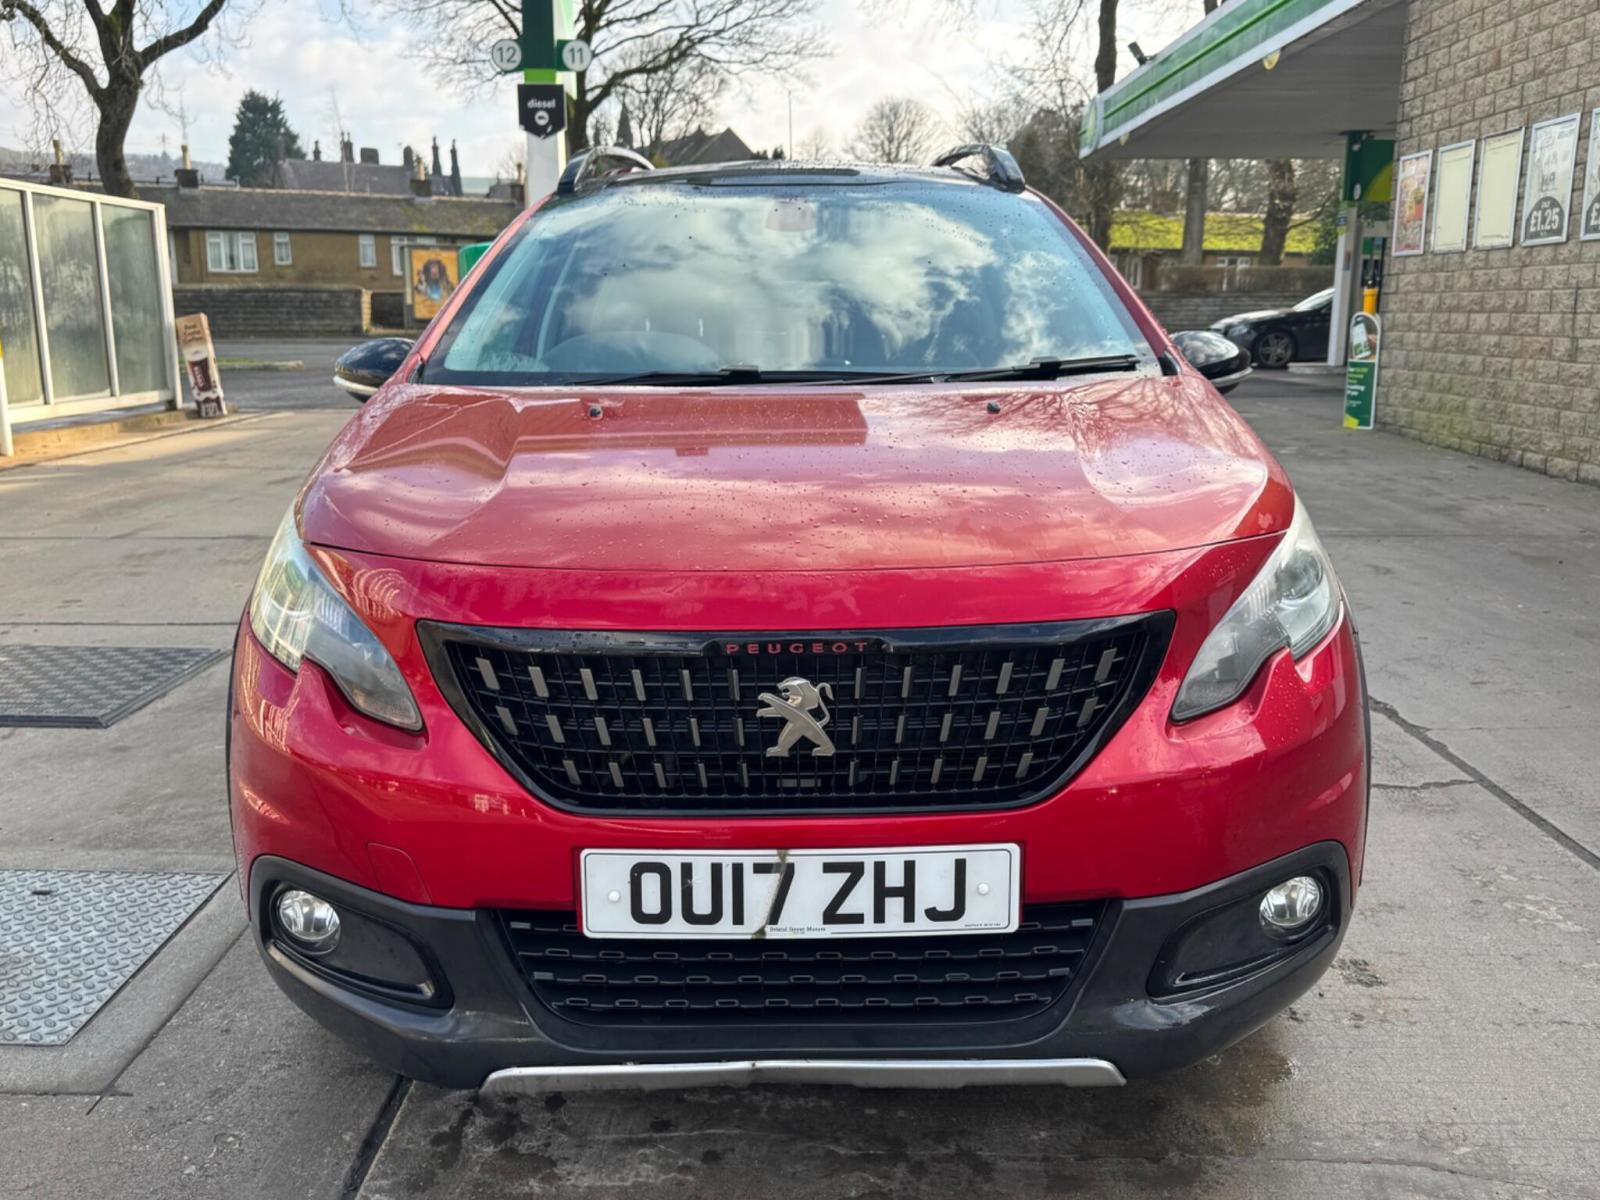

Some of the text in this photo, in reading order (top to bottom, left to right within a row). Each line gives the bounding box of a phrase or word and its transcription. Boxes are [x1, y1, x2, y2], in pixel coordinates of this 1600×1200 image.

[497, 46, 517, 63] 12
[569, 47, 584, 64] 11
[527, 98, 556, 109] diesel
[1529, 207, 1560, 233] £1.25
[725, 642, 867, 654] PEUGEOT
[629, 857, 967, 926] OU17 ZHJ
